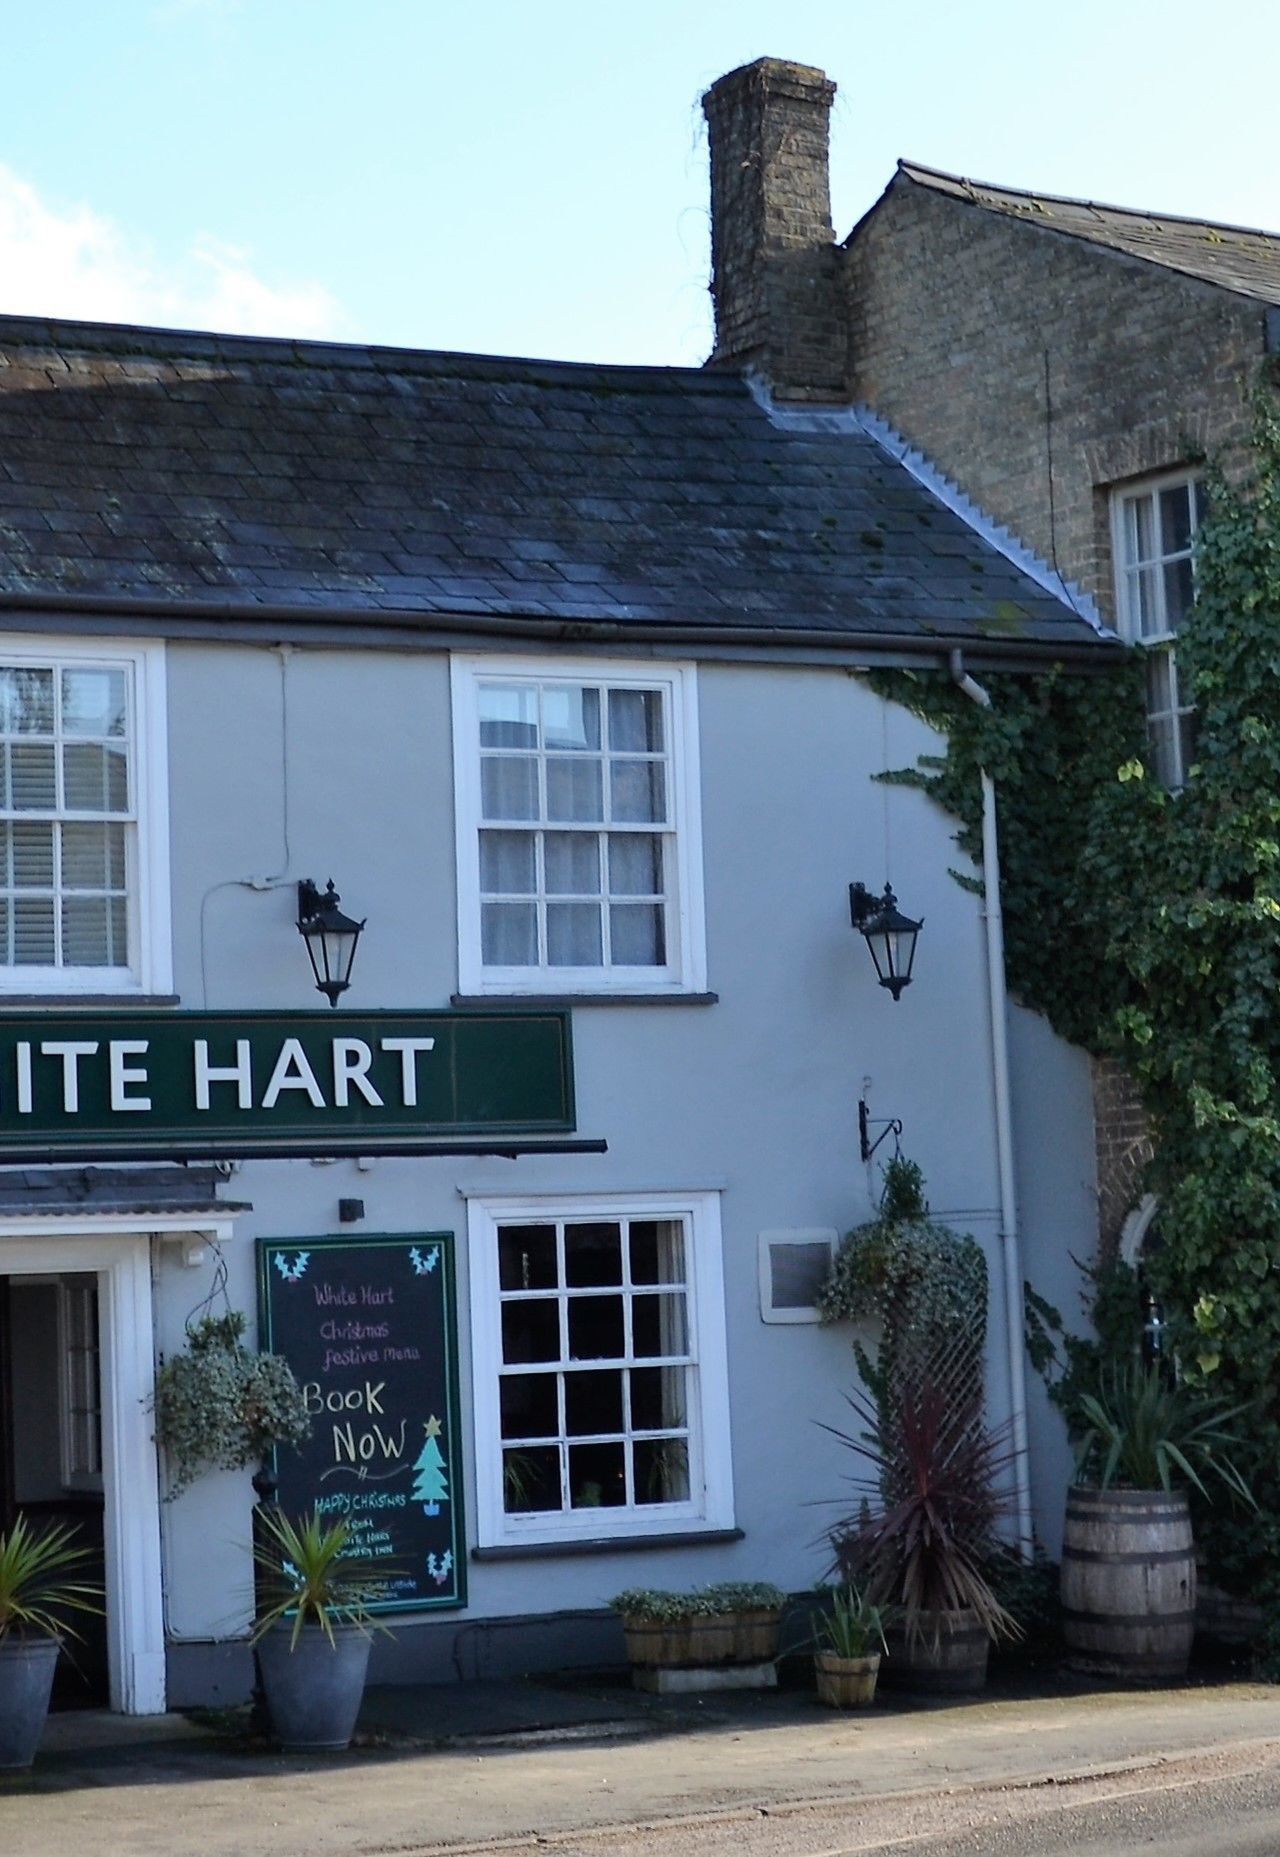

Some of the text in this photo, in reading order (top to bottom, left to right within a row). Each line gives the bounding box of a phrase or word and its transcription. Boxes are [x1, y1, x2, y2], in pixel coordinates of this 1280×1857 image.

[193, 1036, 435, 1109] HART
[314, 1284, 394, 1305] White Hart
[320, 1320, 390, 1340] Christmas
